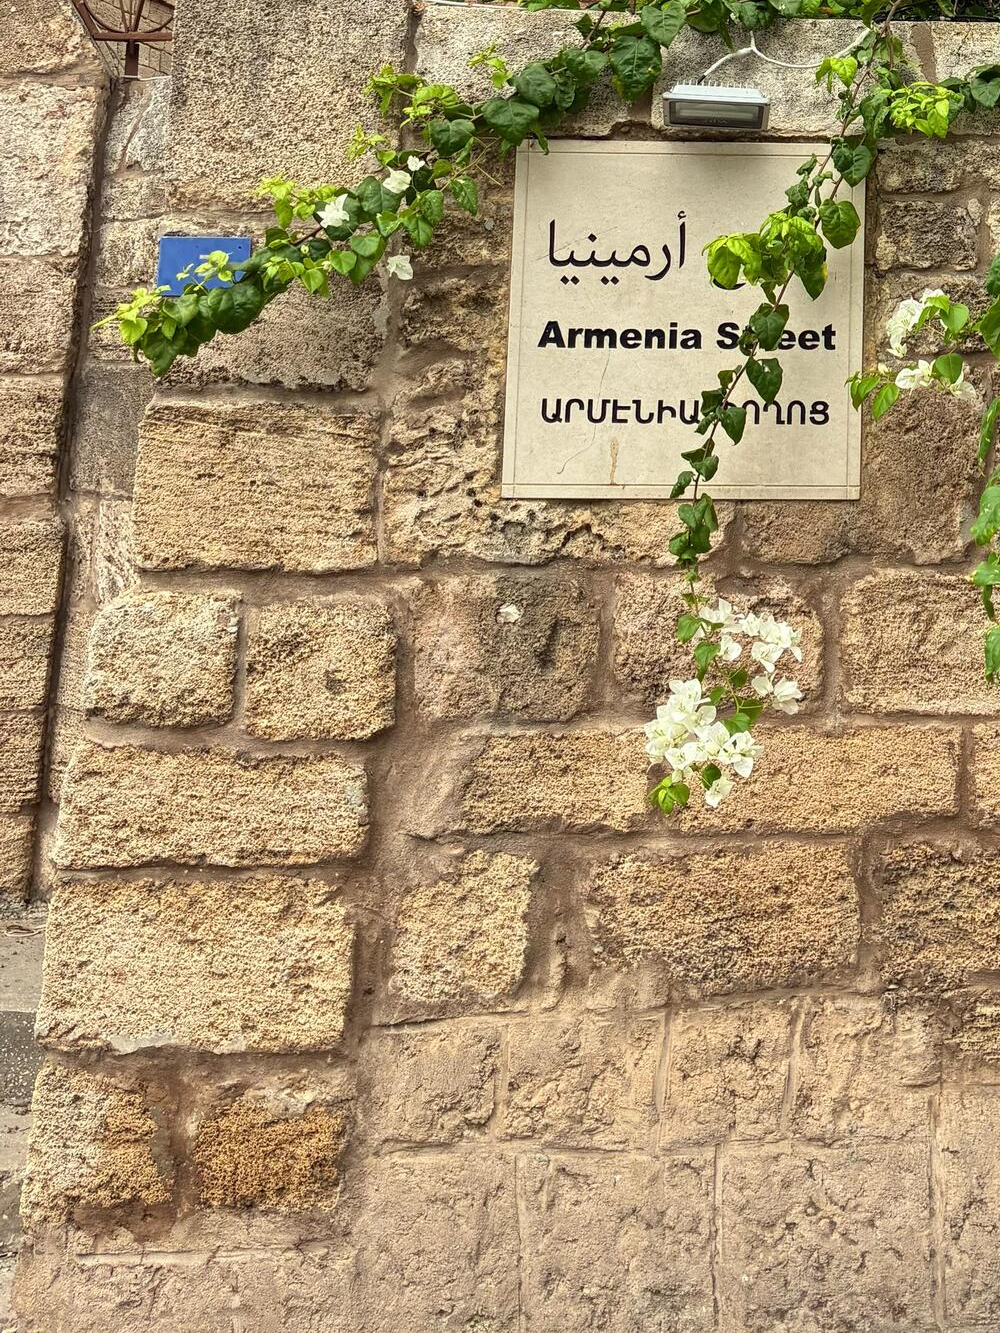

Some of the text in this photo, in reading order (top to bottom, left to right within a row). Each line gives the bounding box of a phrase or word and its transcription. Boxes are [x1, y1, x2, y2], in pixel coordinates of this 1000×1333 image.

[549, 210, 687, 285] أرمينيا
[537, 320, 837, 351] Armenia Seet
[714, 398, 831, 426] ՈՂՈՑ
